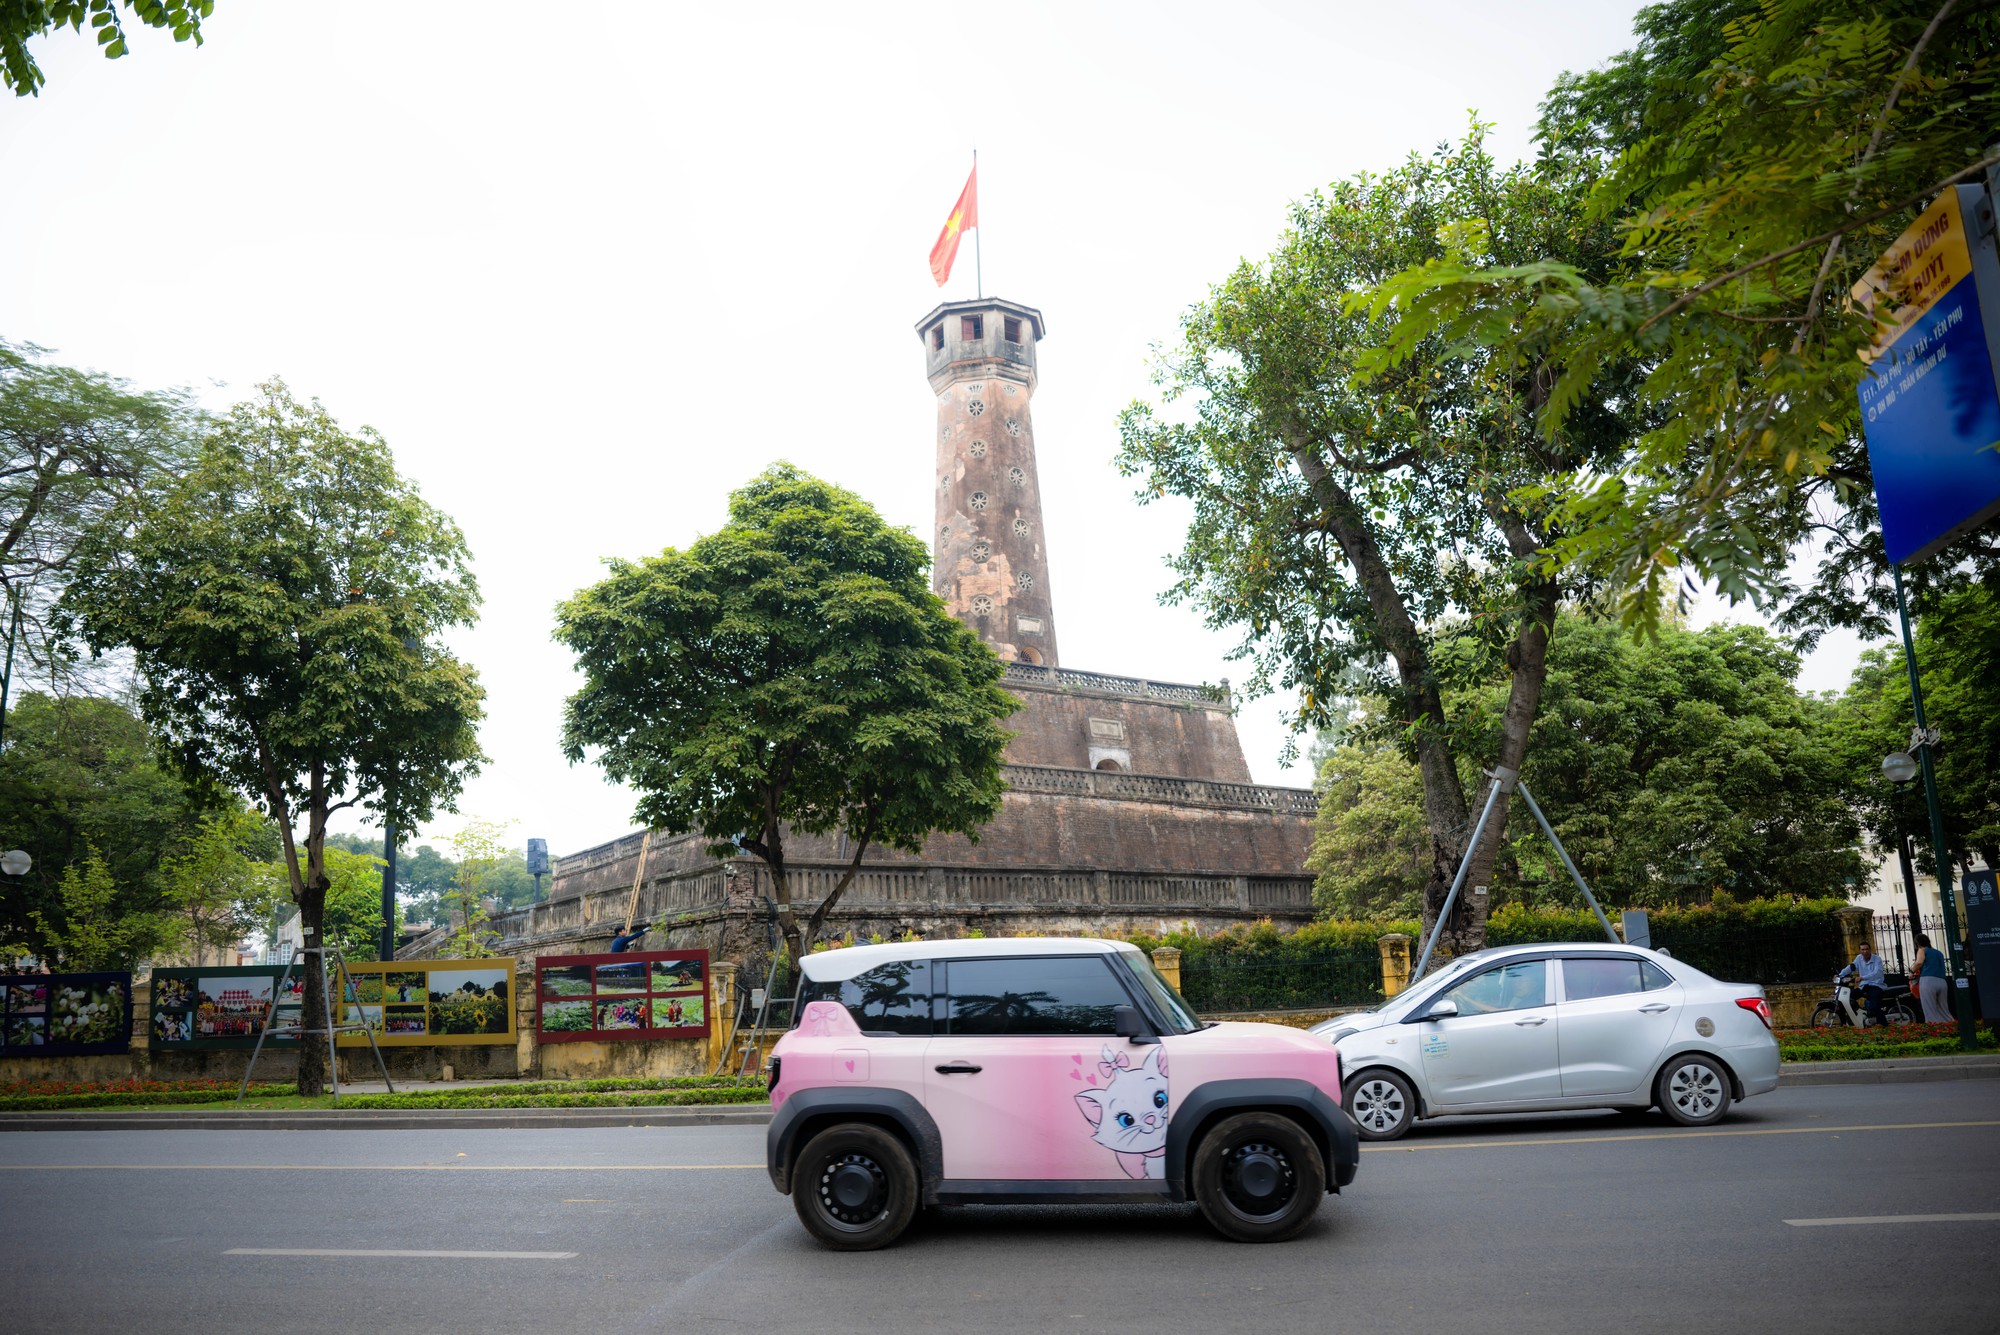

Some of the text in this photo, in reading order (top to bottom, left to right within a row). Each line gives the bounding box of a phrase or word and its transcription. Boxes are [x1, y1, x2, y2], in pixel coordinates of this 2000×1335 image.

[1914, 252, 1944, 296] BUÝT
[1915, 336, 1928, 356] TÂY
[1933, 321, 1947, 340] YÊN
[1947, 305, 1963, 328] PHỤ
